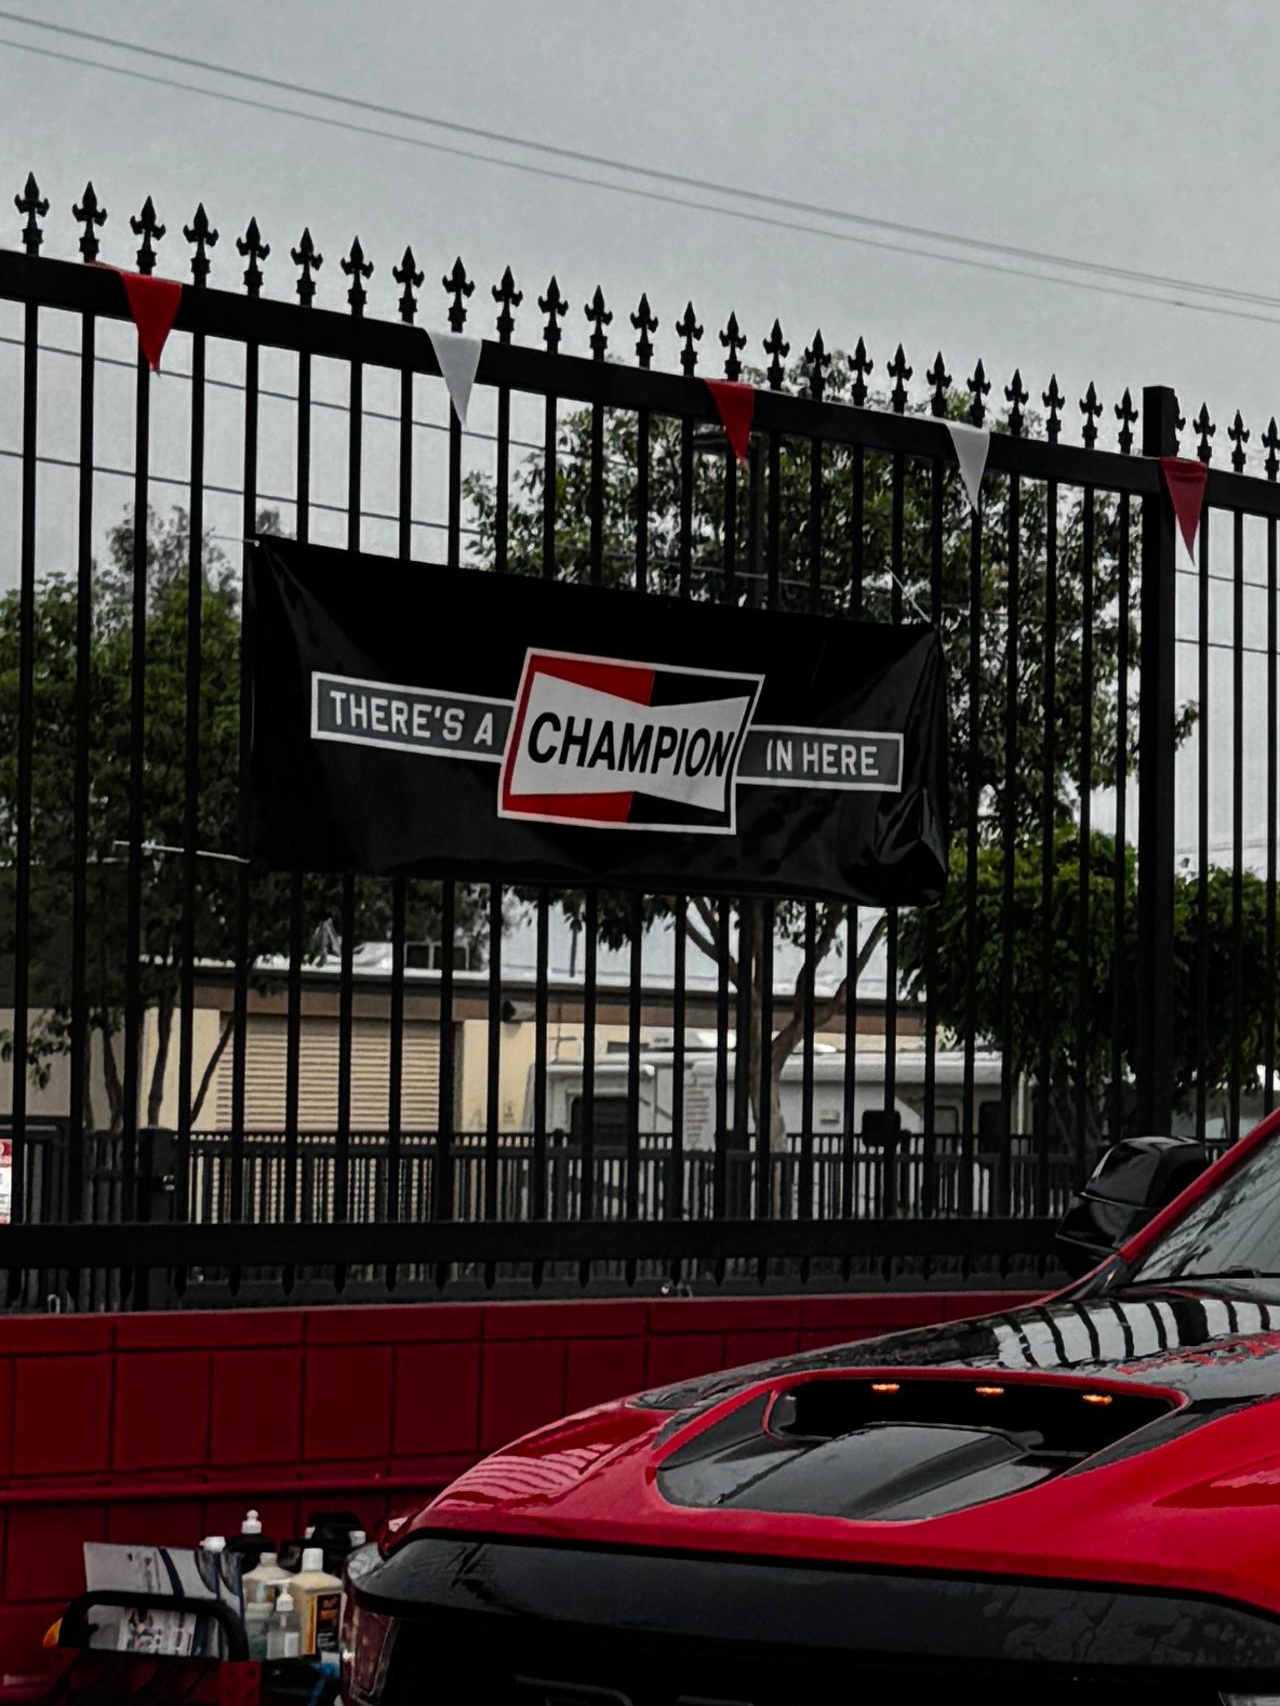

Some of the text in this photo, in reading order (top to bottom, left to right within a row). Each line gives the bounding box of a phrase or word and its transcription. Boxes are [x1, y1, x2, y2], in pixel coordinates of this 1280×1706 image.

[330, 689, 493, 747] THERE'S A
[527, 711, 736, 779] CHAMPION
[765, 737, 879, 777] IN HERE
